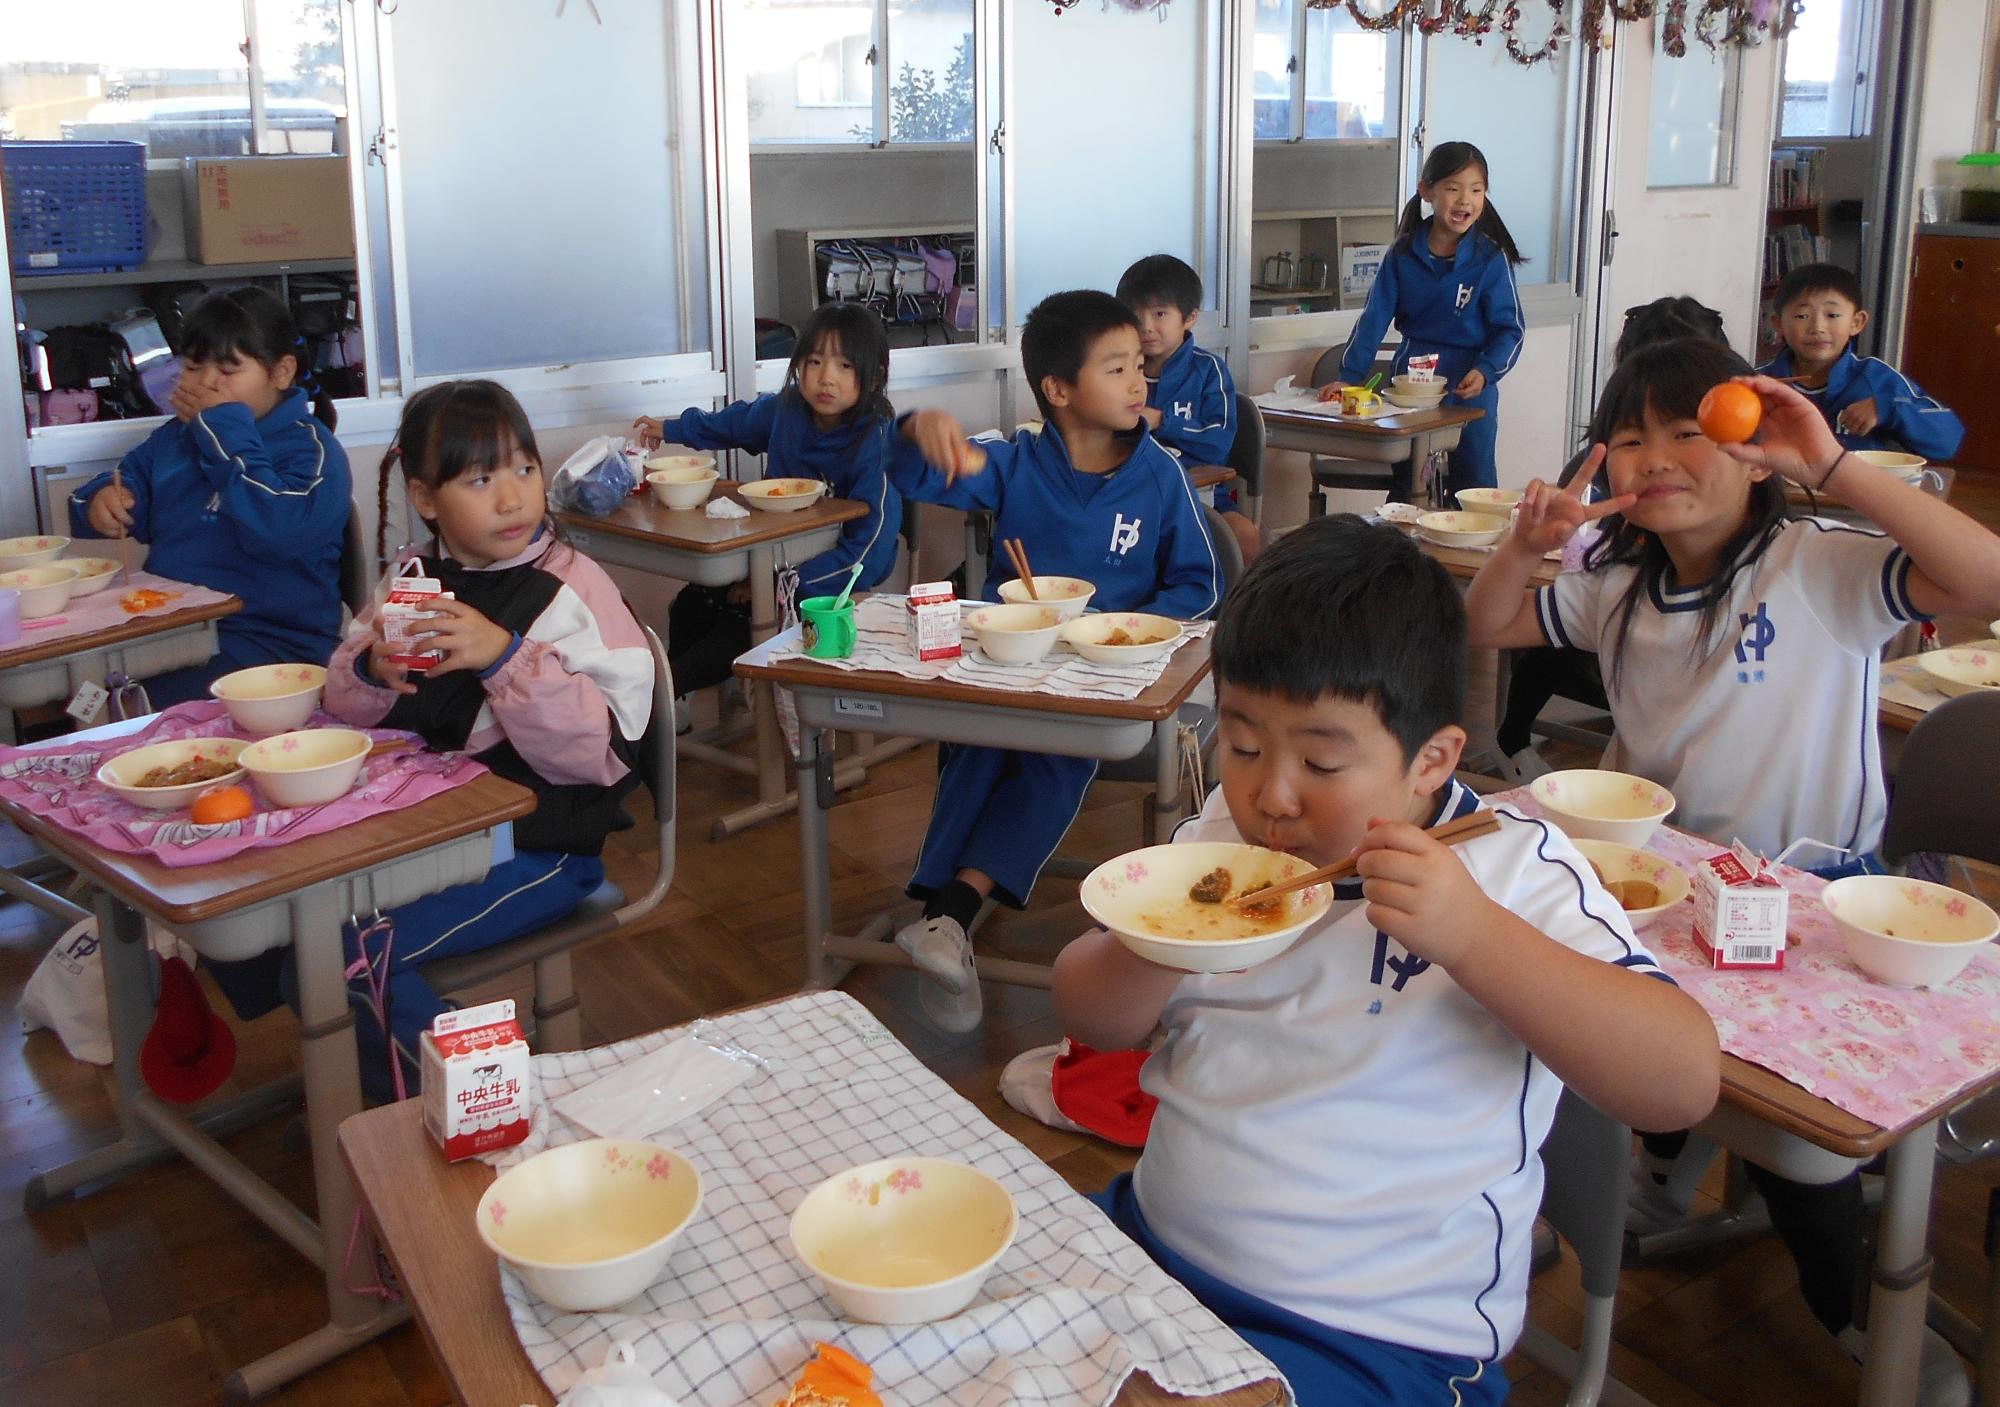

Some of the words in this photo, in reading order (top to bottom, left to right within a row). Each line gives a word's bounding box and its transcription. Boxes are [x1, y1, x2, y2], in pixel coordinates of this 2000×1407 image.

[839, 698, 848, 710] L
[457, 1078, 521, 1107] 中央牛乳
